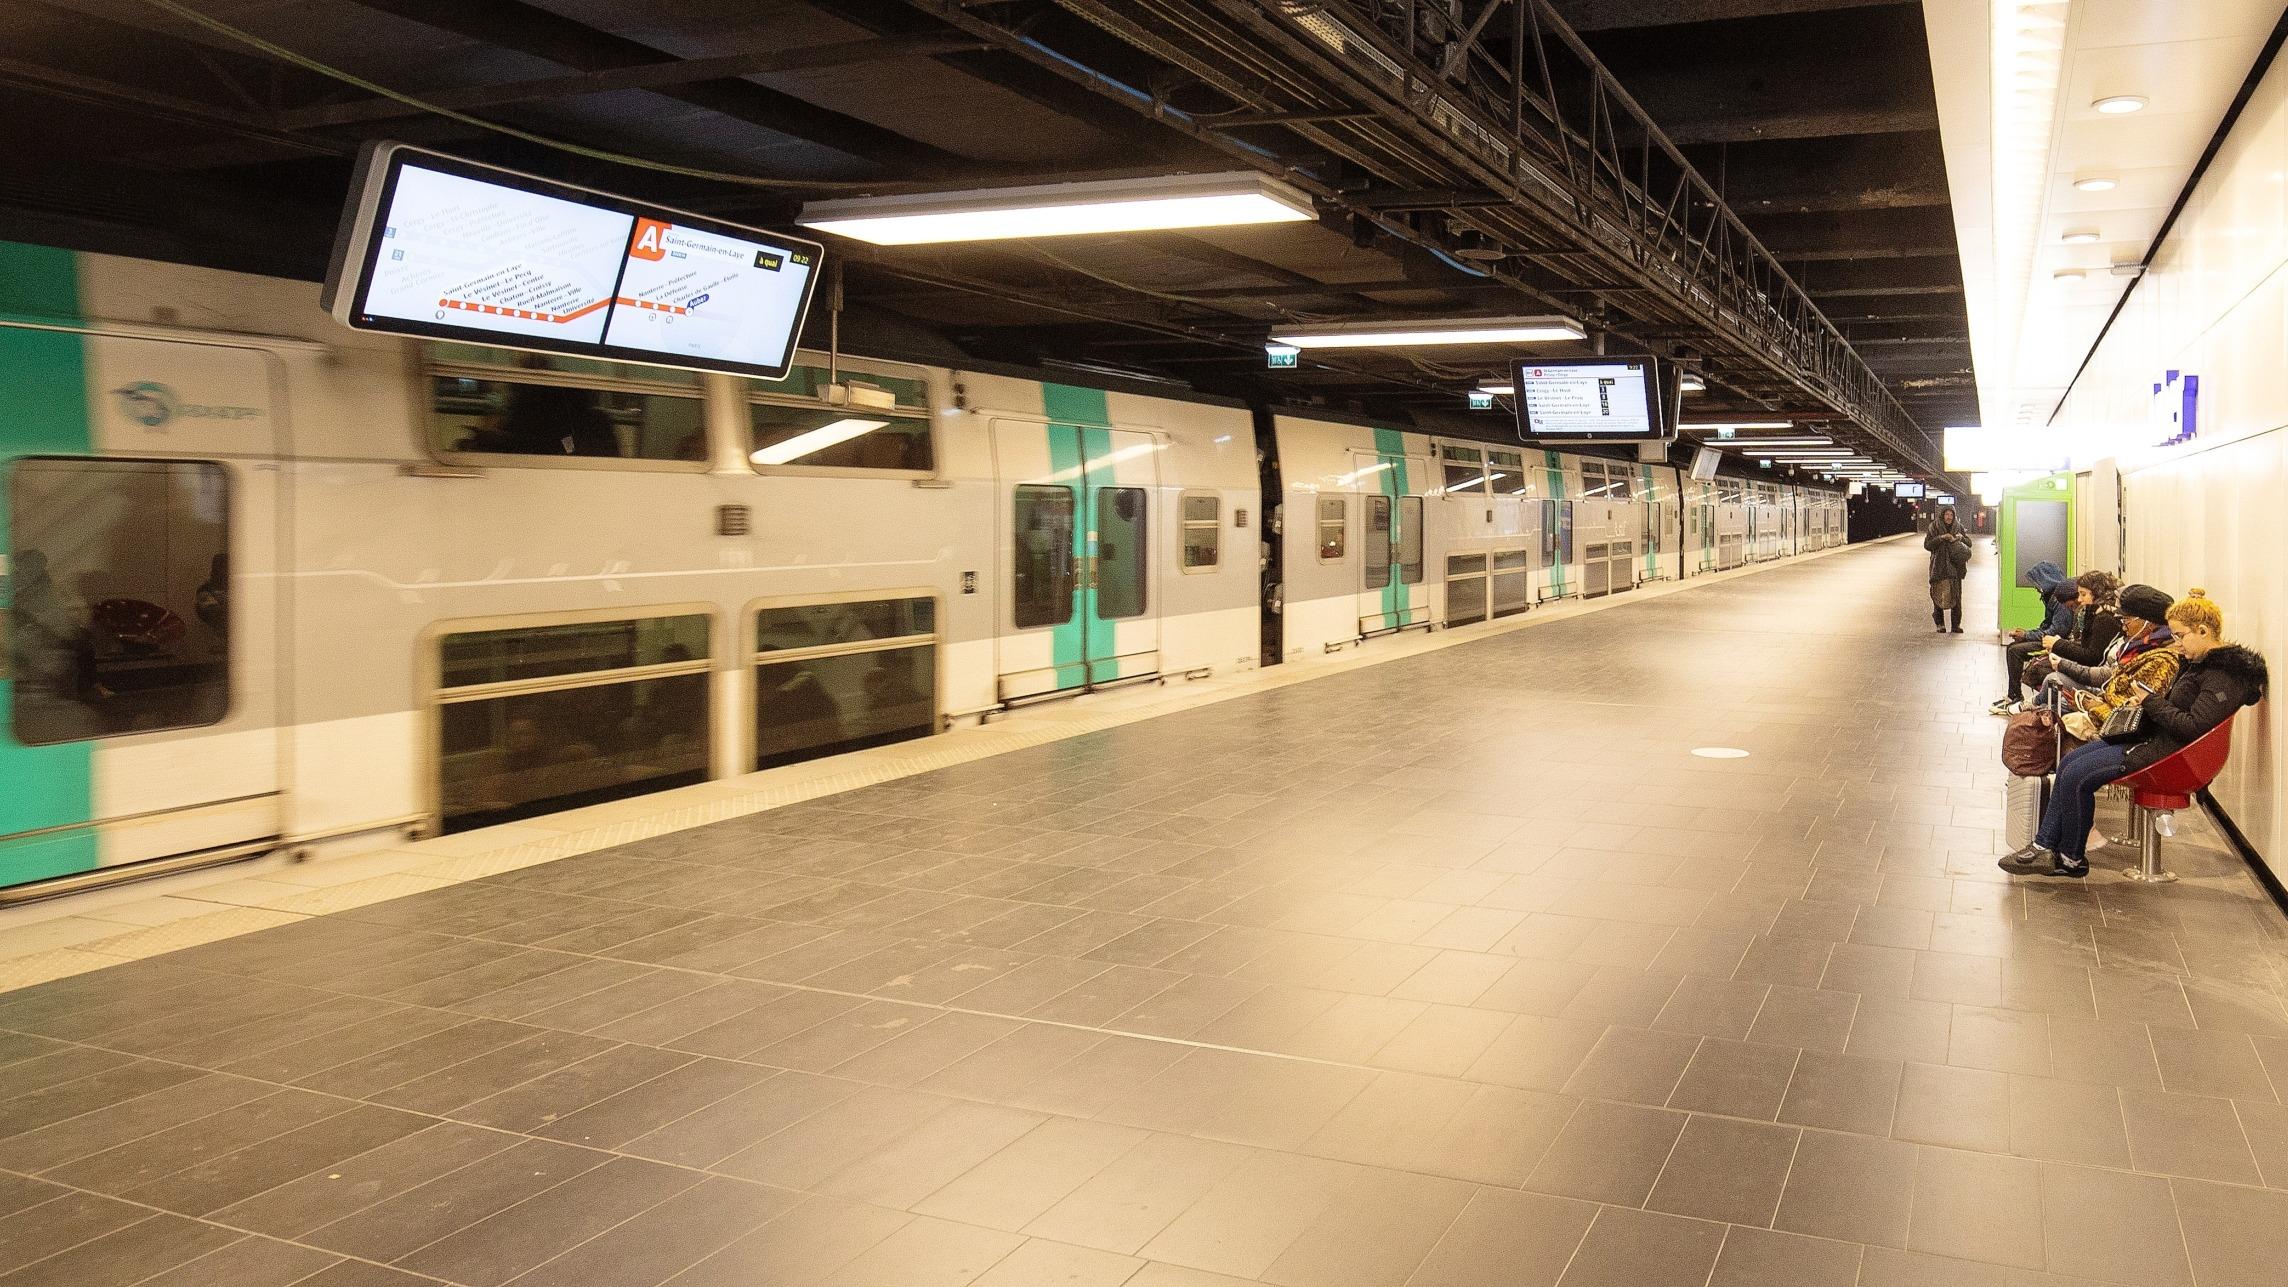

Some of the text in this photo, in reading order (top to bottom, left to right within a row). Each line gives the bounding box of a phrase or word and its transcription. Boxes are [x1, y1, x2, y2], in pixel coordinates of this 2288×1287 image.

[637, 225, 658, 253] A
[666, 236, 744, 260] Saint-Germain-en-Laye
[534, 296, 562, 310] Nanterre
[551, 297, 580, 312] Nanterre
